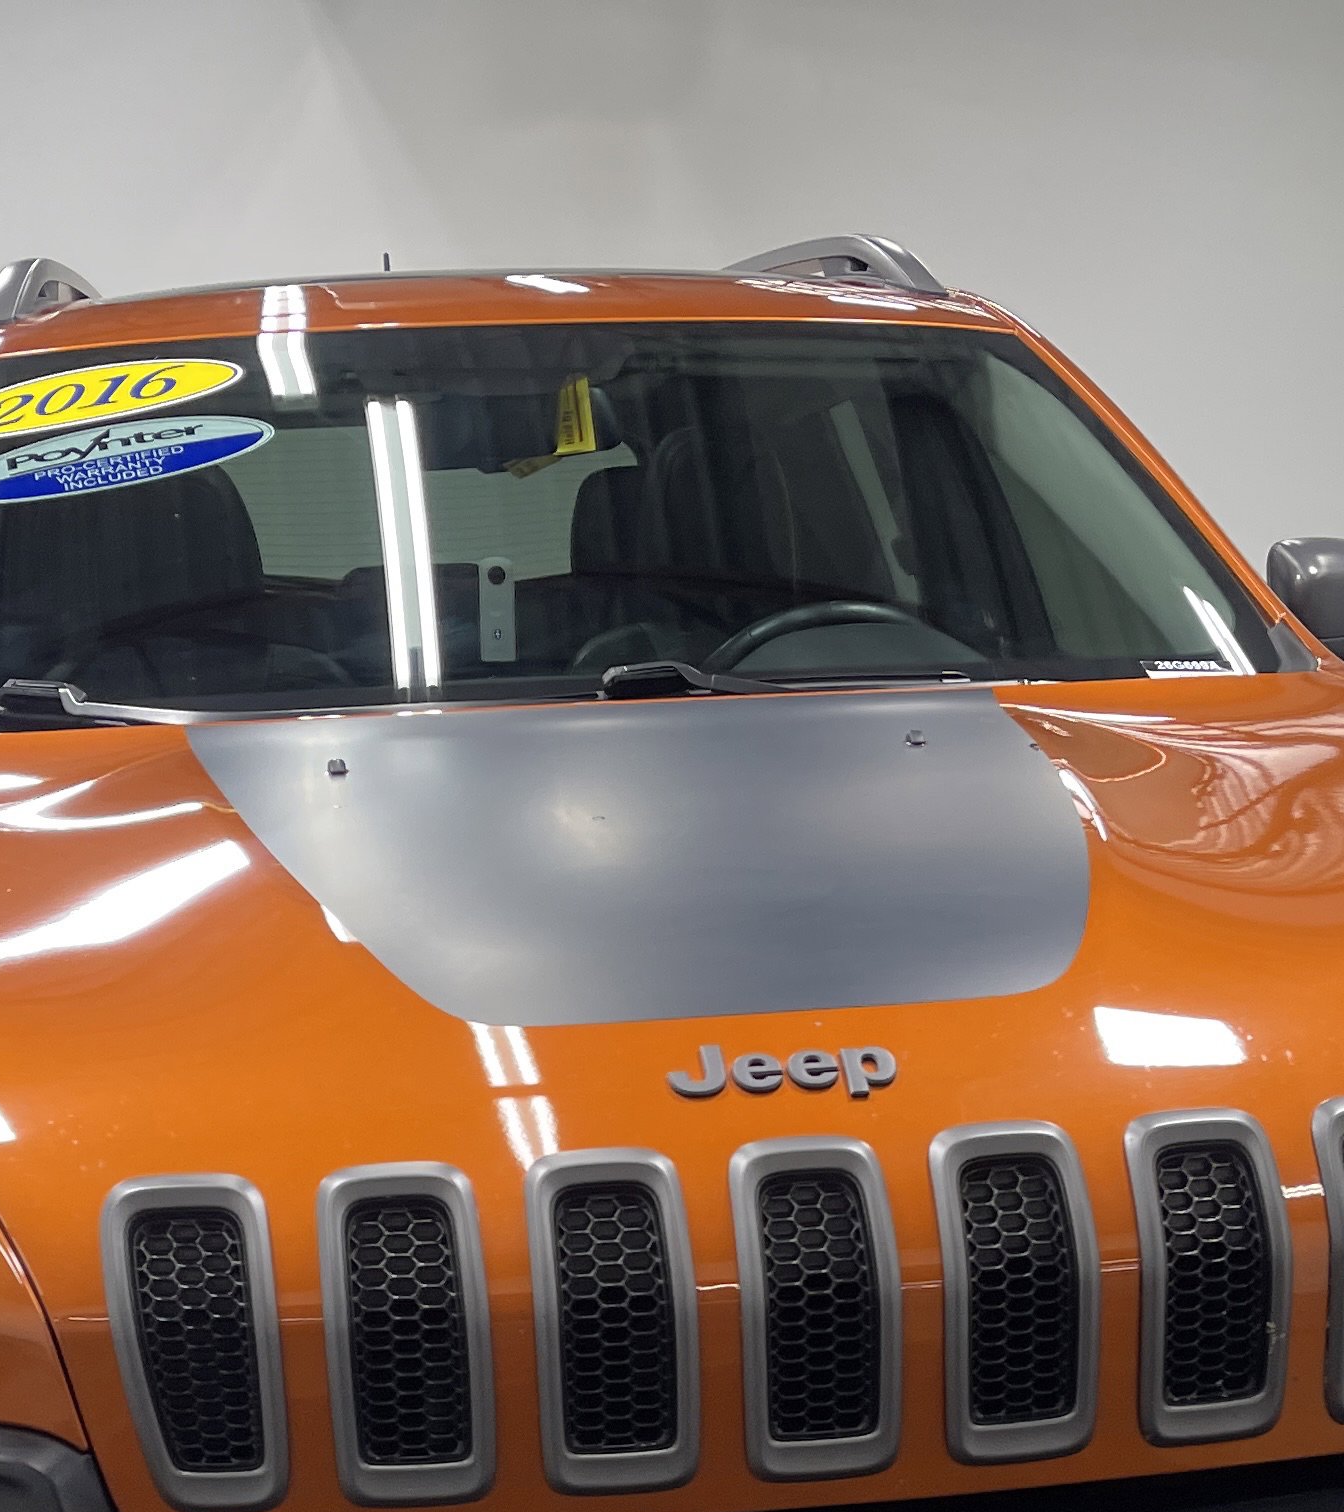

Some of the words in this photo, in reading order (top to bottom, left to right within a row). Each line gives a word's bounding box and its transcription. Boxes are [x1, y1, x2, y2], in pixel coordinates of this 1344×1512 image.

[34, 445, 185, 481] PRO-CERTIFIED
[56, 456, 166, 485] WARRANTY
[63, 466, 164, 492] INCLUDED
[666, 1044, 897, 1099] Jeep
